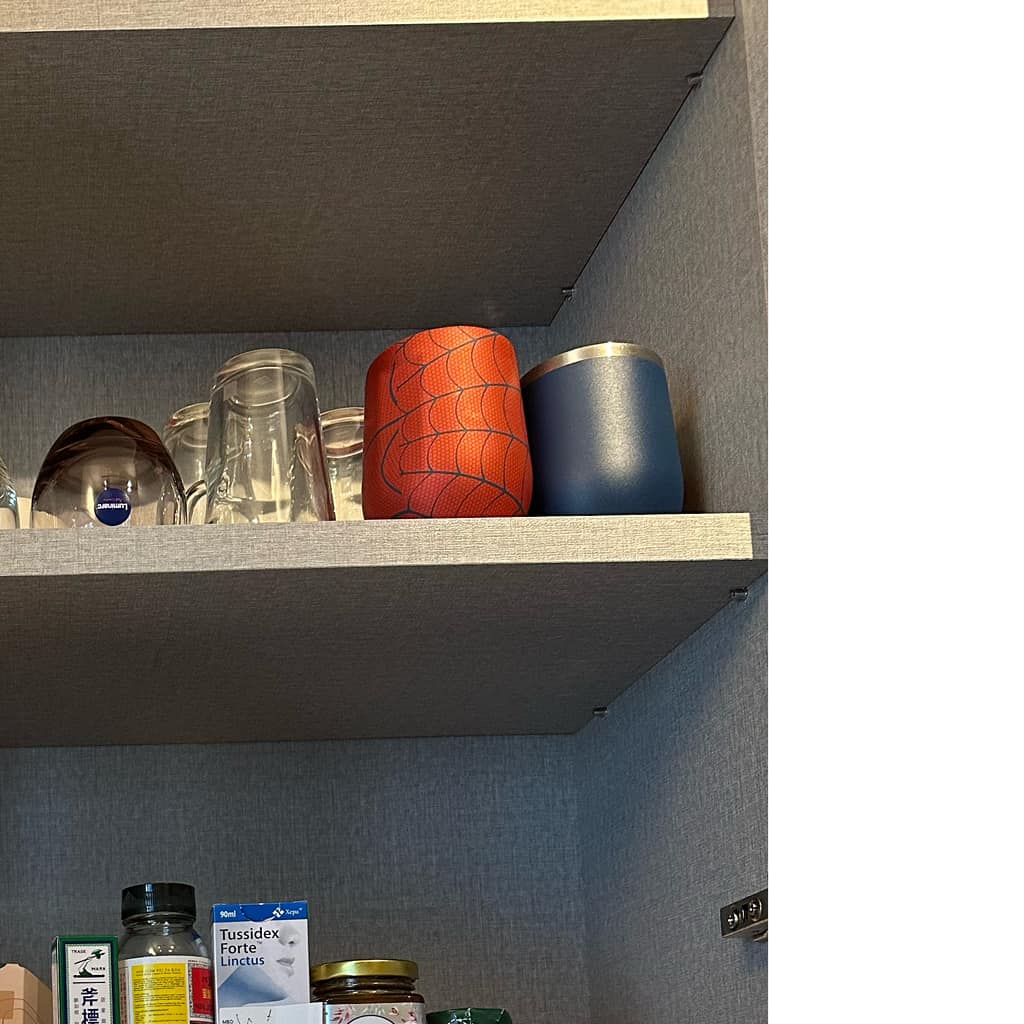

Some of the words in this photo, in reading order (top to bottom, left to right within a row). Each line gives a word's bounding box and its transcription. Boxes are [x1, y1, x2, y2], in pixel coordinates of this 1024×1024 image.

[97, 502, 128, 511] Luminarc
[220, 910, 236, 918] 90ml
[219, 927, 280, 941] Tussidex
[221, 956, 265, 967] Linctus
